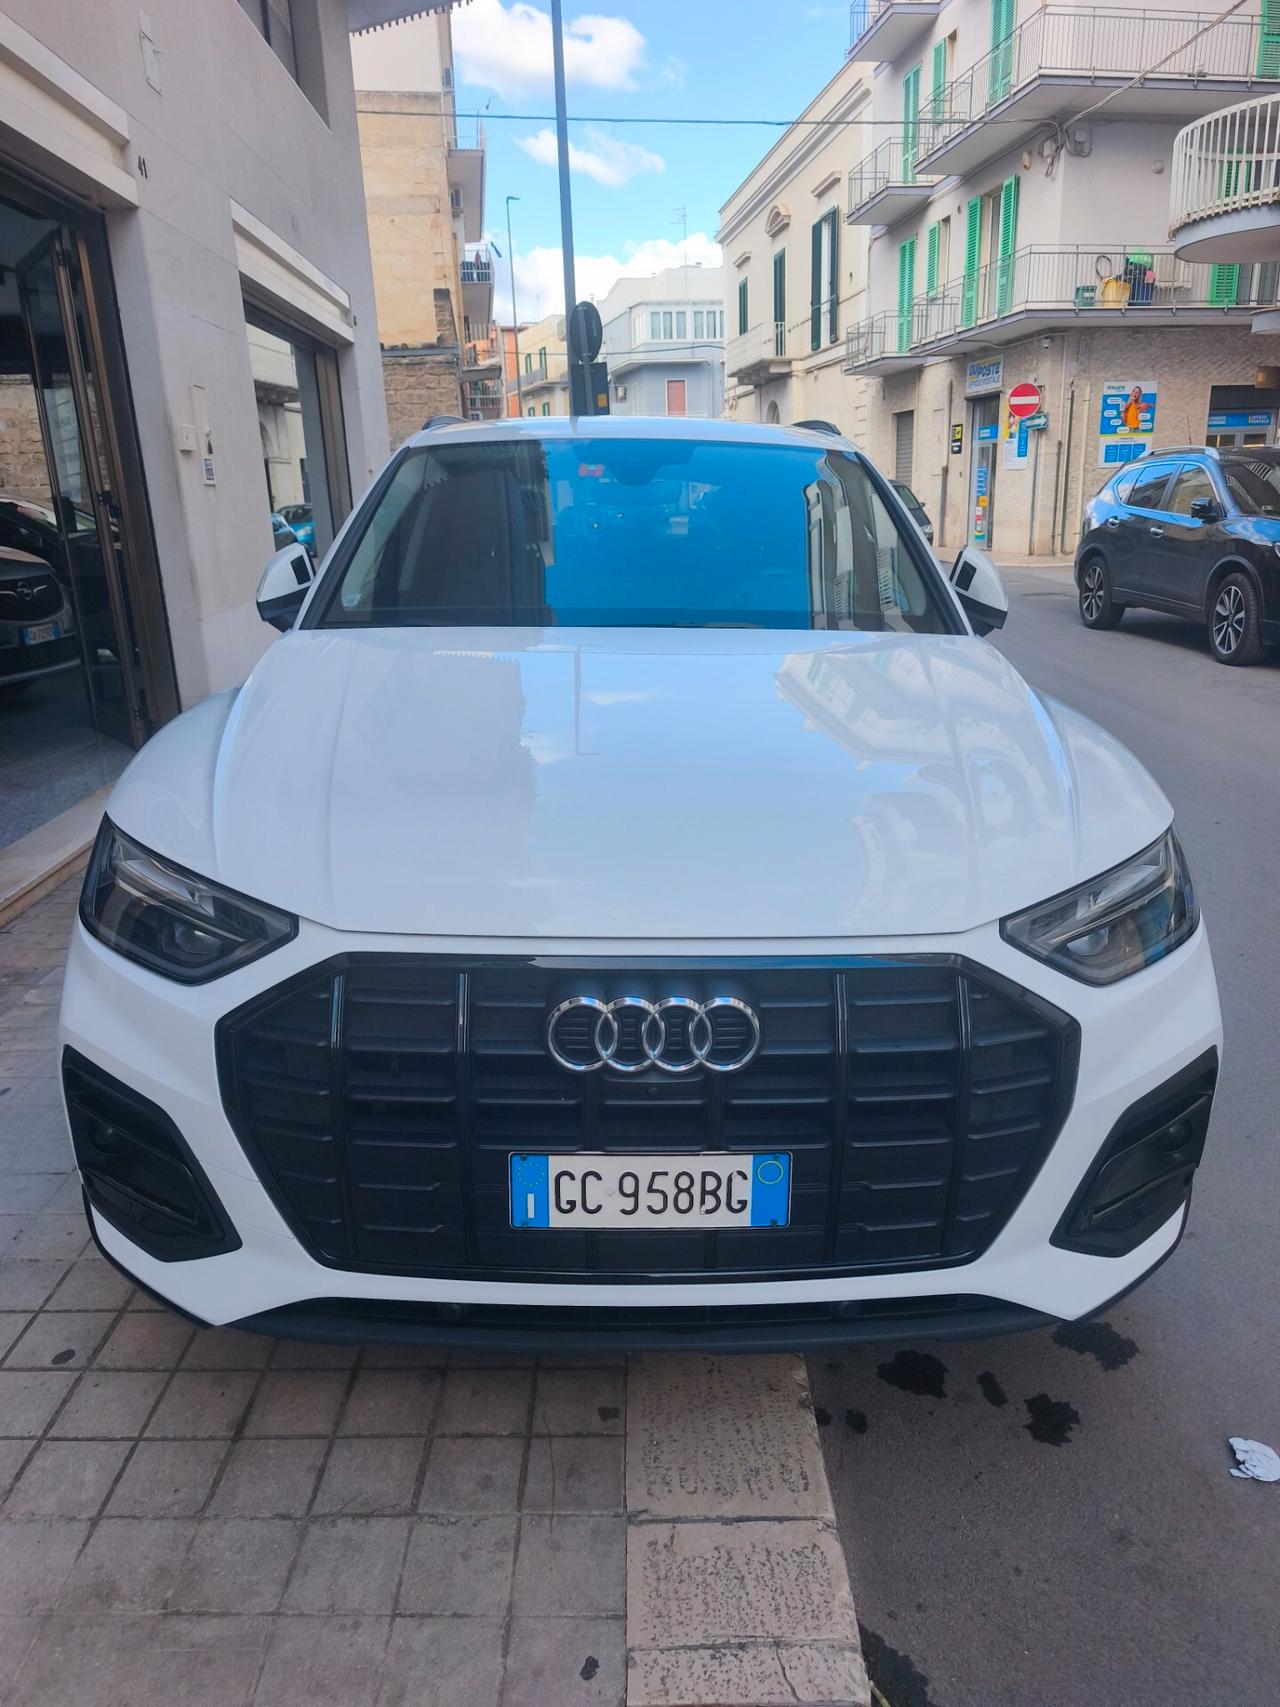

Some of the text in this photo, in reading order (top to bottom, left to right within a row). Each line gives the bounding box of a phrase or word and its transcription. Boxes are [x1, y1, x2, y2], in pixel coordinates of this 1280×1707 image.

[137, 155, 148, 179] 41
[554, 1170, 603, 1215] GC
[618, 1170, 748, 1216] 958BG
